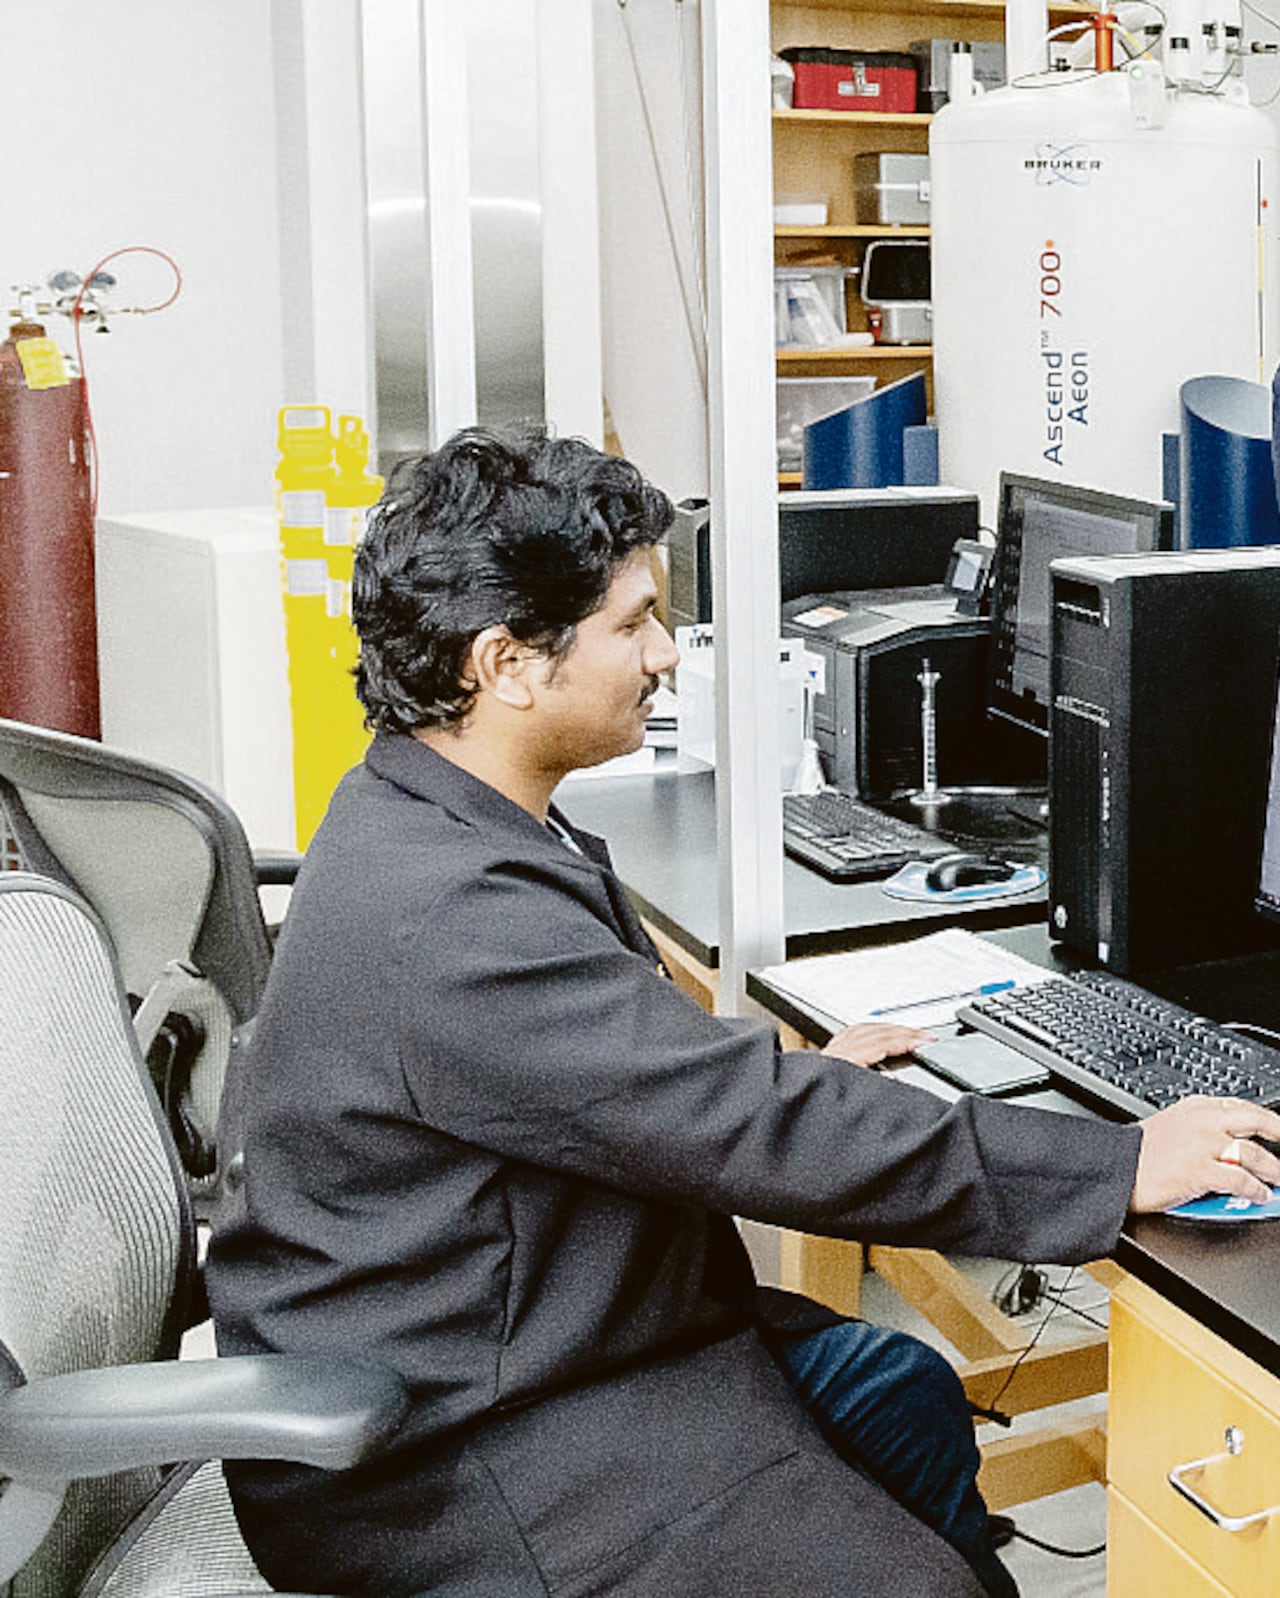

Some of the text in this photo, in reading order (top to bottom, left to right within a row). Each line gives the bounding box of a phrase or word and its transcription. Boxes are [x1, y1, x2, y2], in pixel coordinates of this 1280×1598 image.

[1024, 159, 1101, 170] BRUKER
[1040, 251, 1061, 318] 700
[1067, 352, 1088, 425] Aeon
